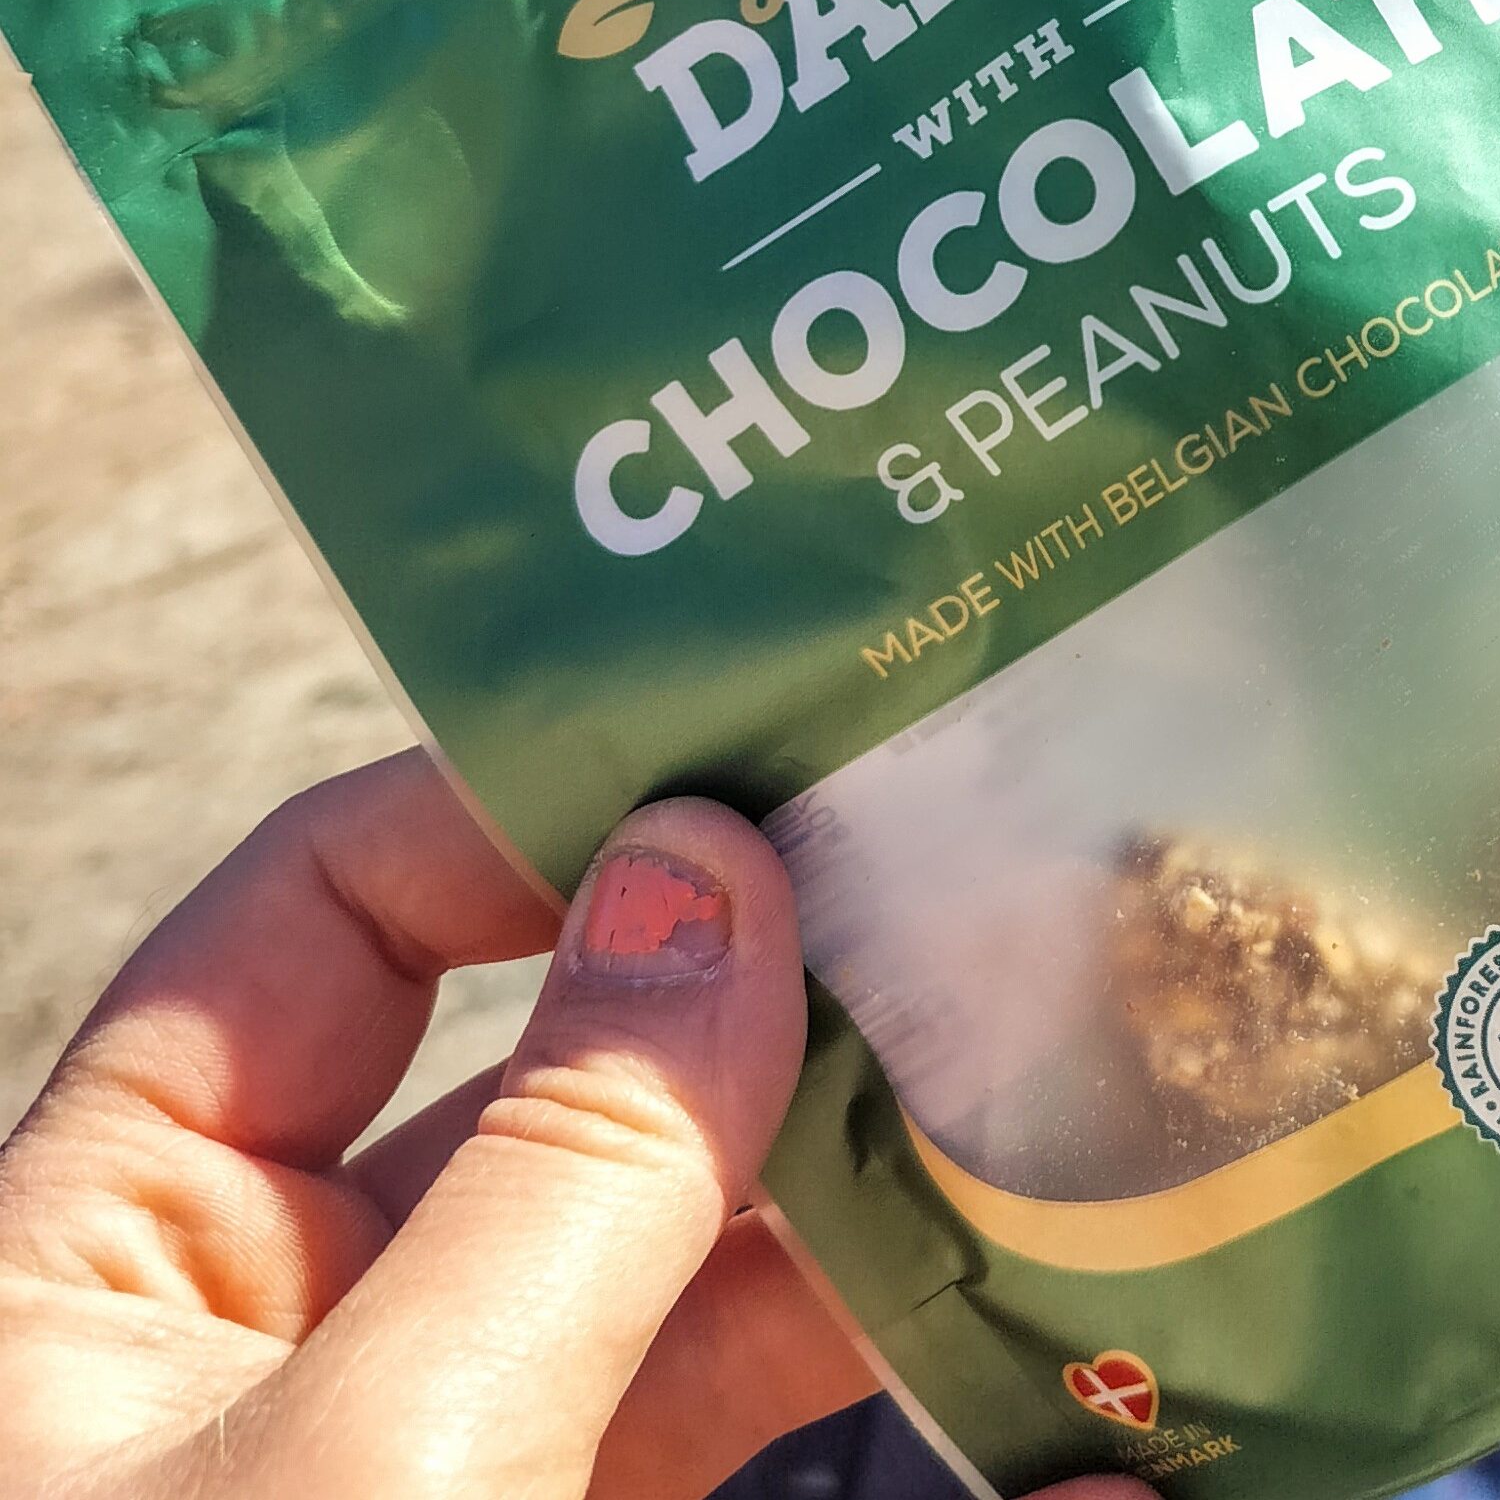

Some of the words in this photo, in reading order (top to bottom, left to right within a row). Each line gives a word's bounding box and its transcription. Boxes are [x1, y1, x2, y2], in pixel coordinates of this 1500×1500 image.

[893, 18, 1075, 160] WITH
[876, 442, 965, 525] &
[945, 146, 1418, 477] PEANUTS
[860, 572, 1001, 678] MADE
[994, 503, 1105, 591] WITH
[1101, 382, 1294, 526] BELGIAN
